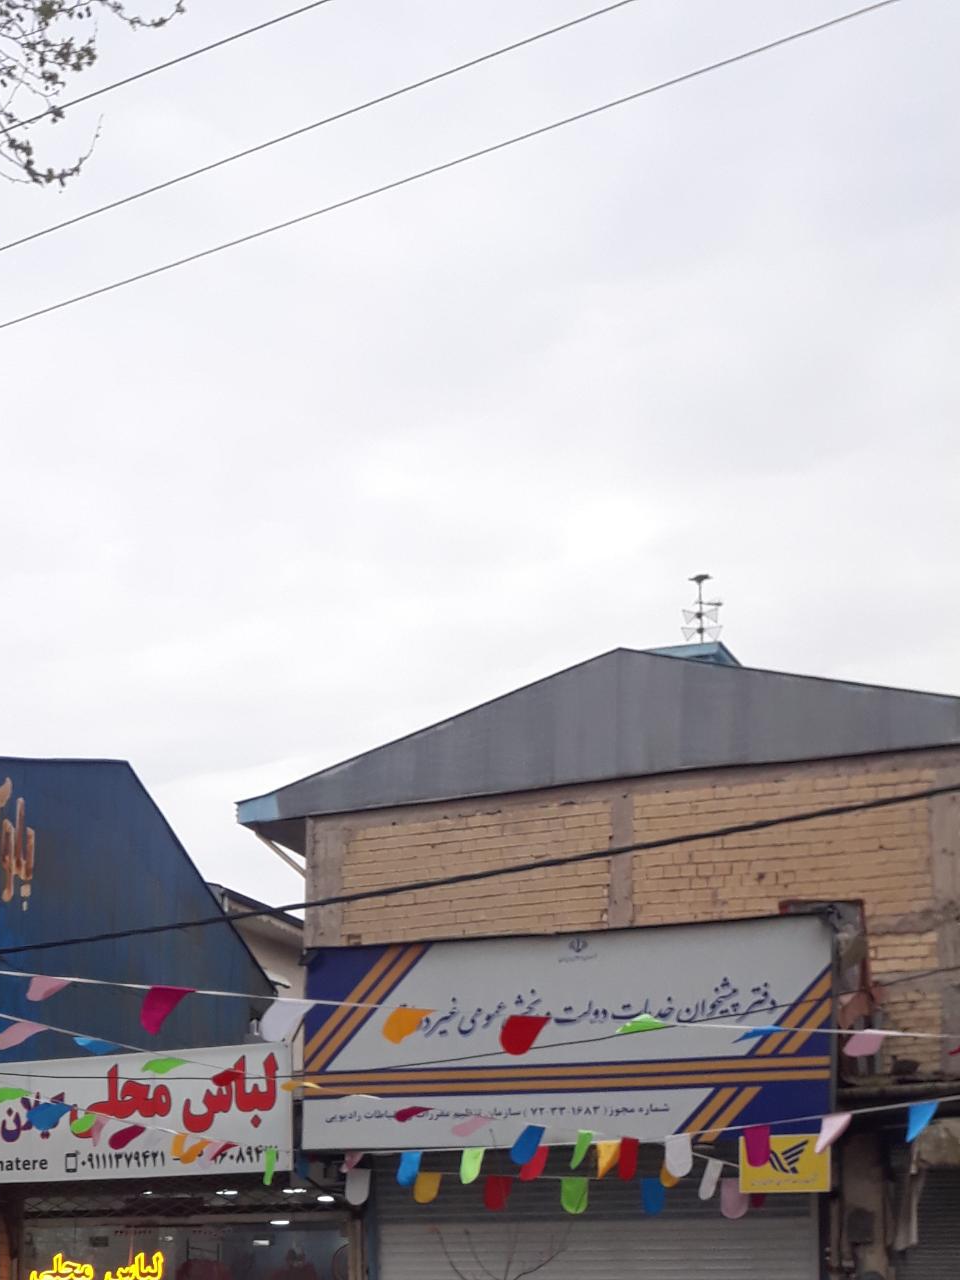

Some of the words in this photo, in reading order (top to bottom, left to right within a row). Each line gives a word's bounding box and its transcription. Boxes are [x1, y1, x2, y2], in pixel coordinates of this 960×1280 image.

[457, 1000, 507, 1035] عمومی
[551, 1000, 609, 1024] دولت
[610, 995, 675, 1021] خدات
[675, 976, 740, 1023] پیشخوان
[734, 981, 779, 1023] دفتر
[69, 1064, 172, 1139] محلی
[183, 1052, 279, 1133] لباس
[639, 1101, 672, 1116] شماره
[1, 1091, 66, 1143] لان
